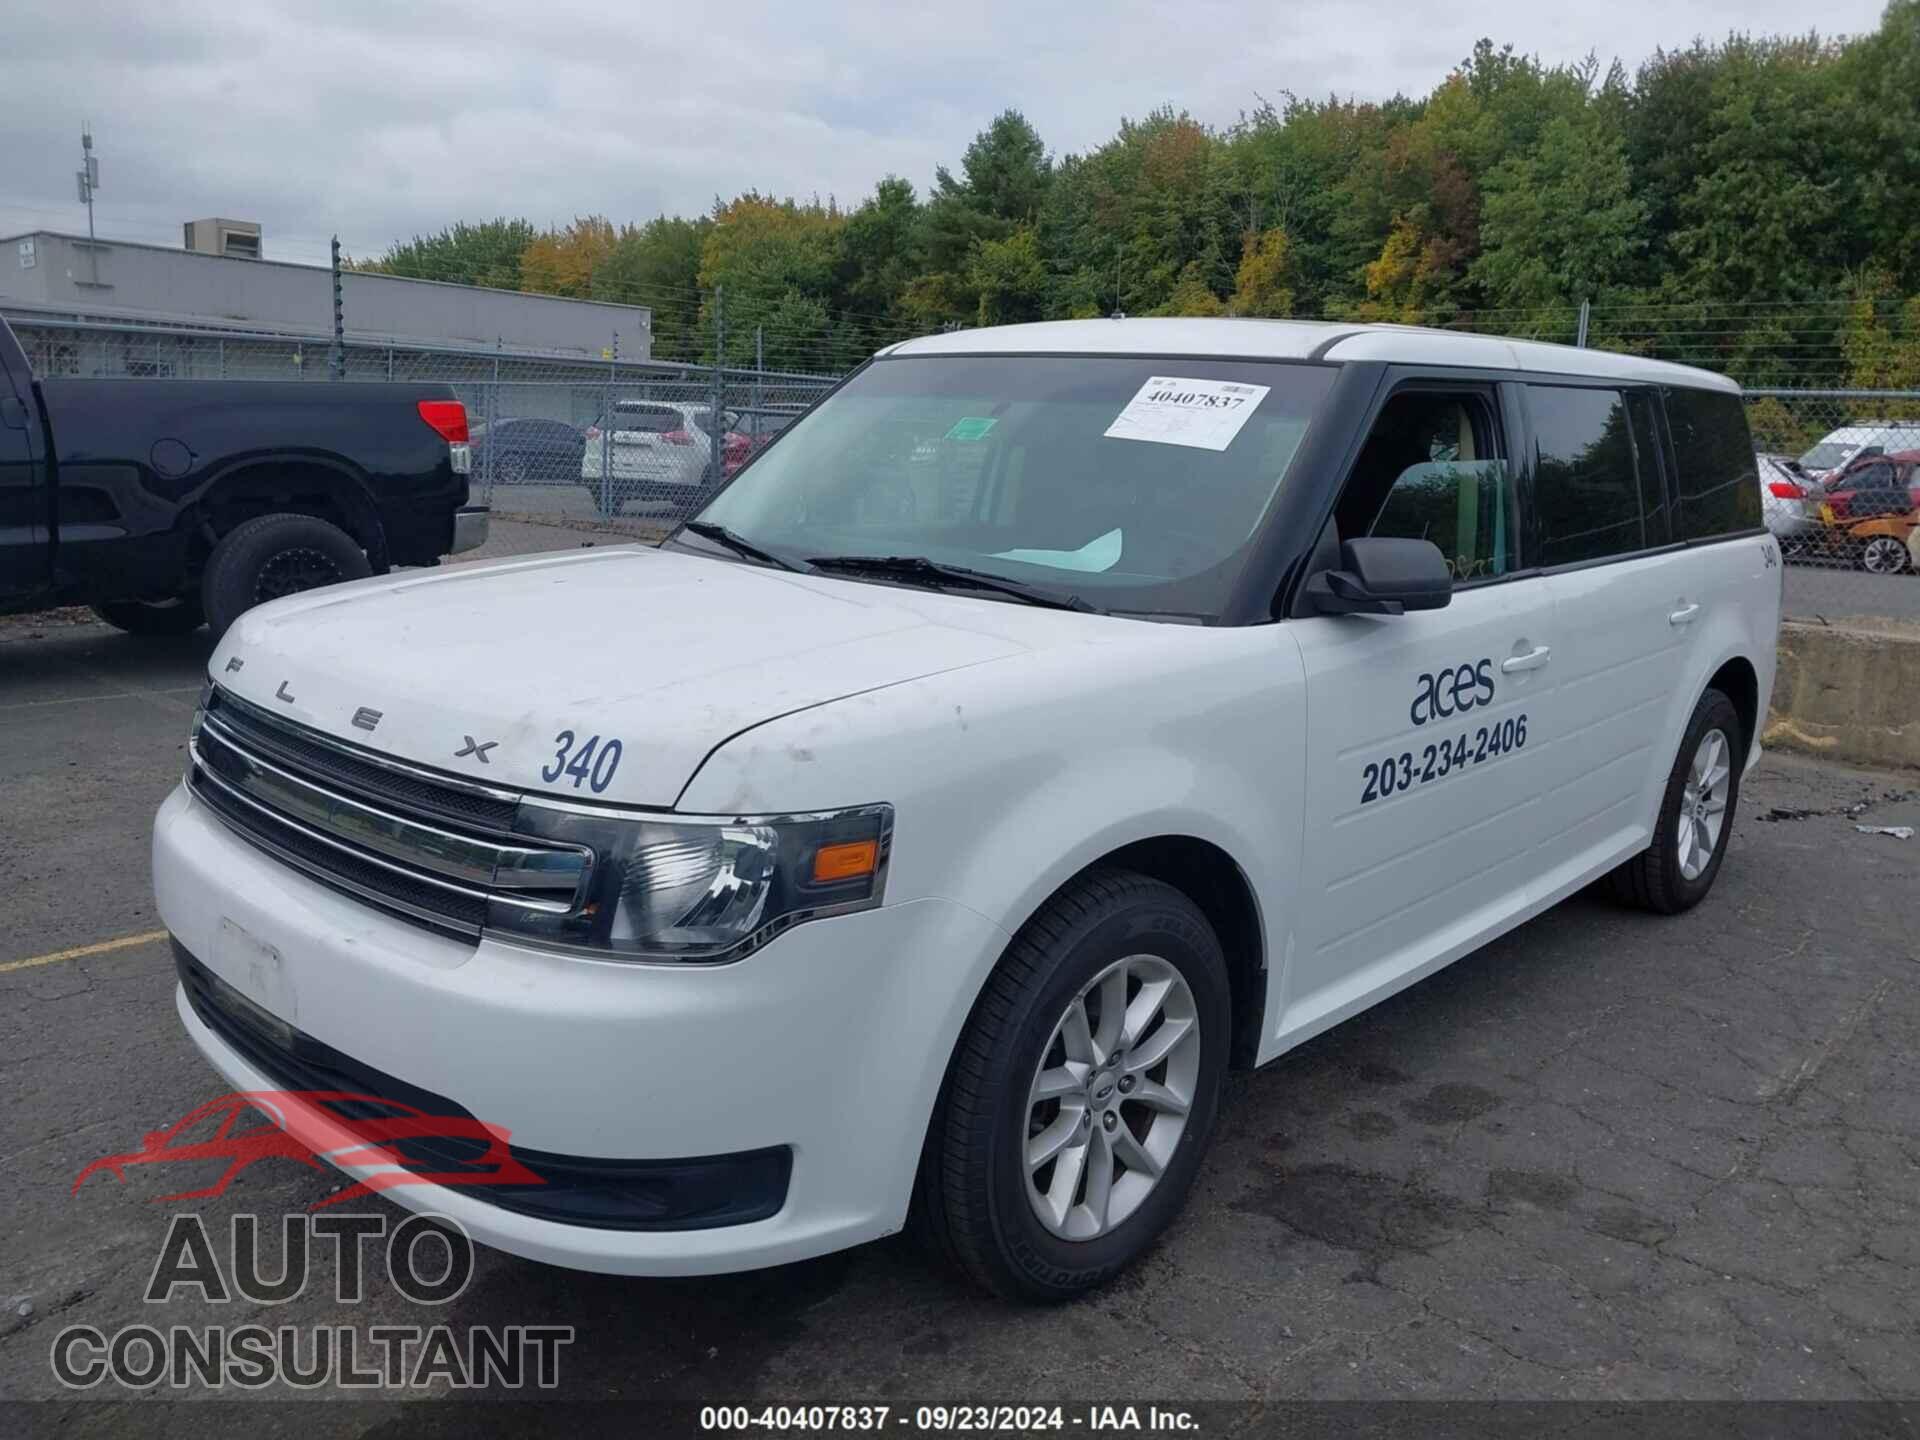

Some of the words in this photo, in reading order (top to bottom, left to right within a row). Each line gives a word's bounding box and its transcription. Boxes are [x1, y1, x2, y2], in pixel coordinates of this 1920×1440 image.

[1147, 390, 1245, 409] 40407837
[225, 656, 499, 764] FLEX
[1411, 658, 1495, 726] aces
[541, 730, 622, 793] 340
[1361, 714, 1528, 805] 203-234-2406
